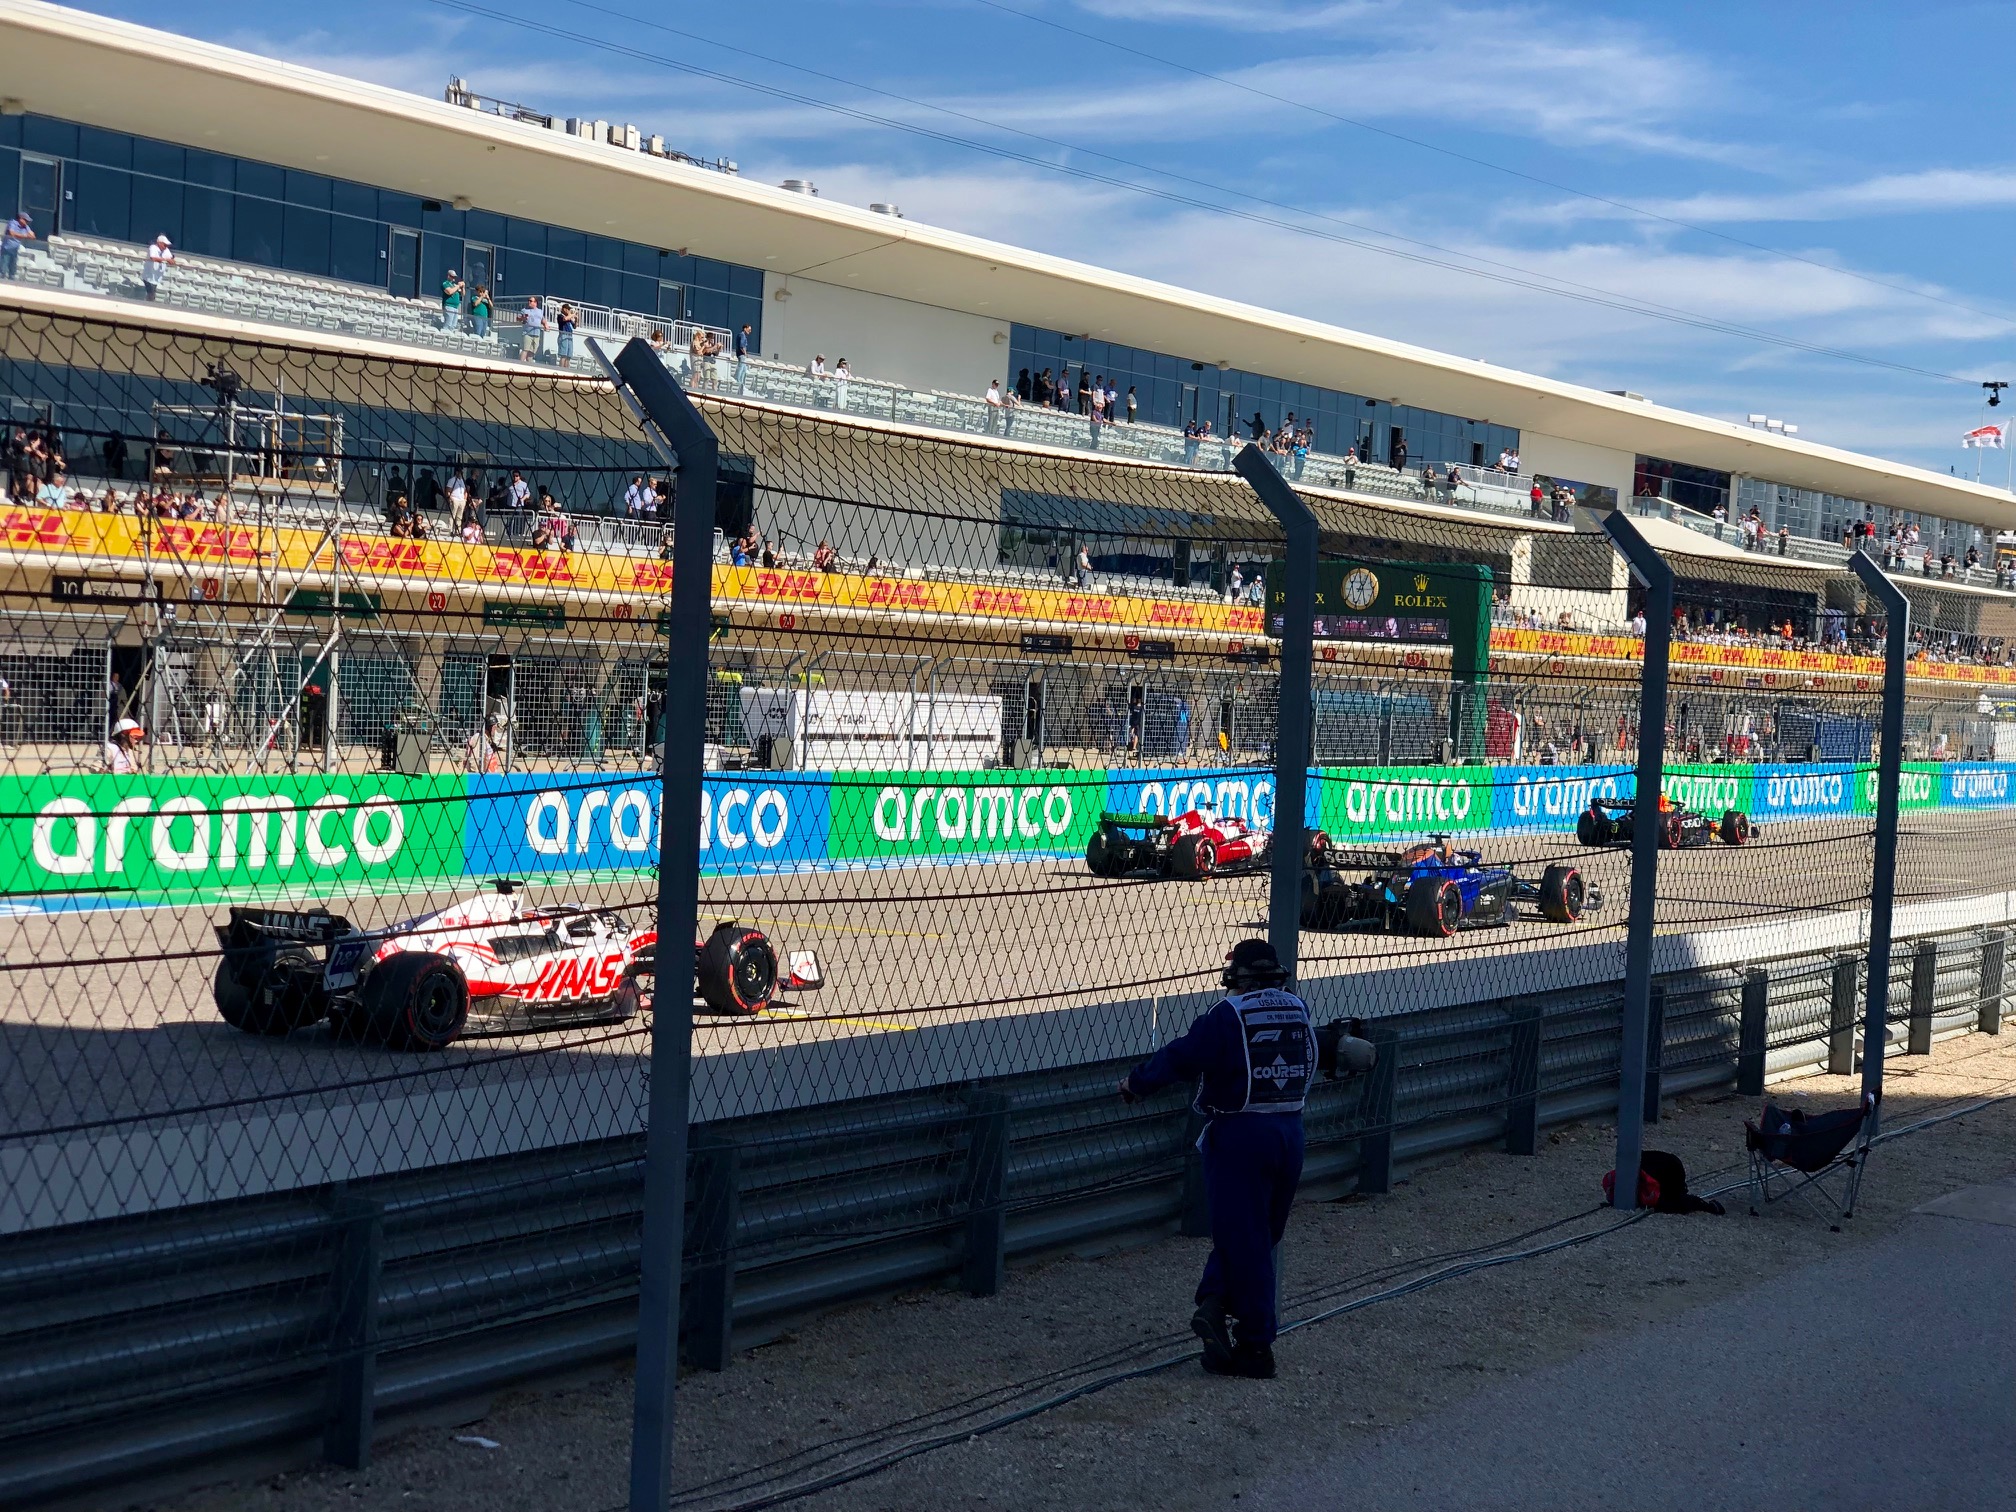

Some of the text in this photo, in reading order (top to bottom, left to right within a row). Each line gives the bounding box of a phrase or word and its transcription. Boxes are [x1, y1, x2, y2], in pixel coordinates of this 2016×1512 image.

[0, 514, 68, 544] HL
[154, 525, 262, 558] DHL
[336, 539, 427, 571] DHL
[491, 552, 572, 581] DHL
[630, 563, 673, 588] DH
[755, 573, 820, 598] DHL
[432, 595, 442, 608] 22
[868, 582, 928, 606] DHL
[970, 589, 1025, 612] DHL
[1064, 597, 1114, 619] DHL
[1394, 595, 1447, 608] ROLEX
[1150, 603, 1195, 624] DHL
[1514, 776, 1617, 816] aramco
[1660, 775, 1738, 809] ramco
[1767, 773, 1842, 807] aramco
[1865, 771, 1931, 802] amco
[1952, 769, 2007, 798] aramco
[873, 786, 1073, 841] aramco
[1139, 781, 1276, 827] aramc
[1346, 779, 1471, 823] aramco
[32, 794, 405, 874] aramco
[521, 953, 624, 1001] HAAS
